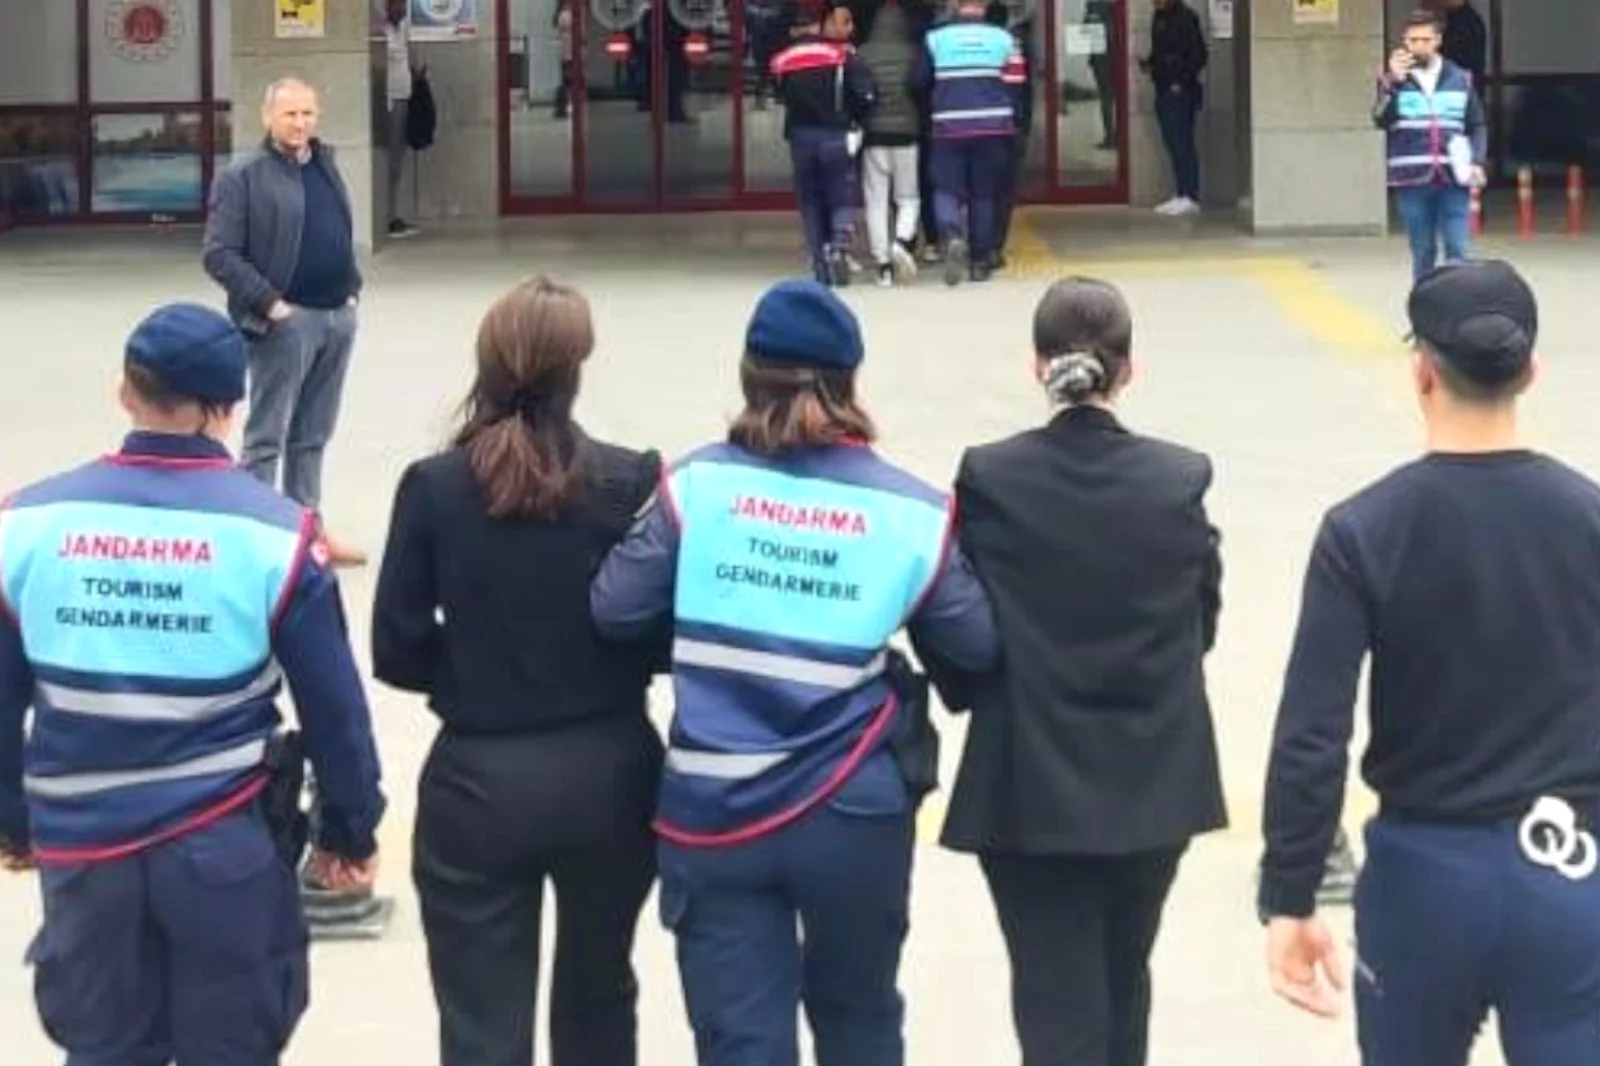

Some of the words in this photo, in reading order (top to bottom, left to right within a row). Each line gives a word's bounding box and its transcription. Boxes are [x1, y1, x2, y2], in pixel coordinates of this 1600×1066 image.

[729, 497, 866, 535] JANDARMA
[57, 534, 211, 562] JANDARMA
[748, 537, 838, 567] TOURISM
[82, 577, 182, 601] TOURISM
[715, 564, 862, 601] GENDARMERIE
[55, 607, 213, 633] GENDARMERIE
